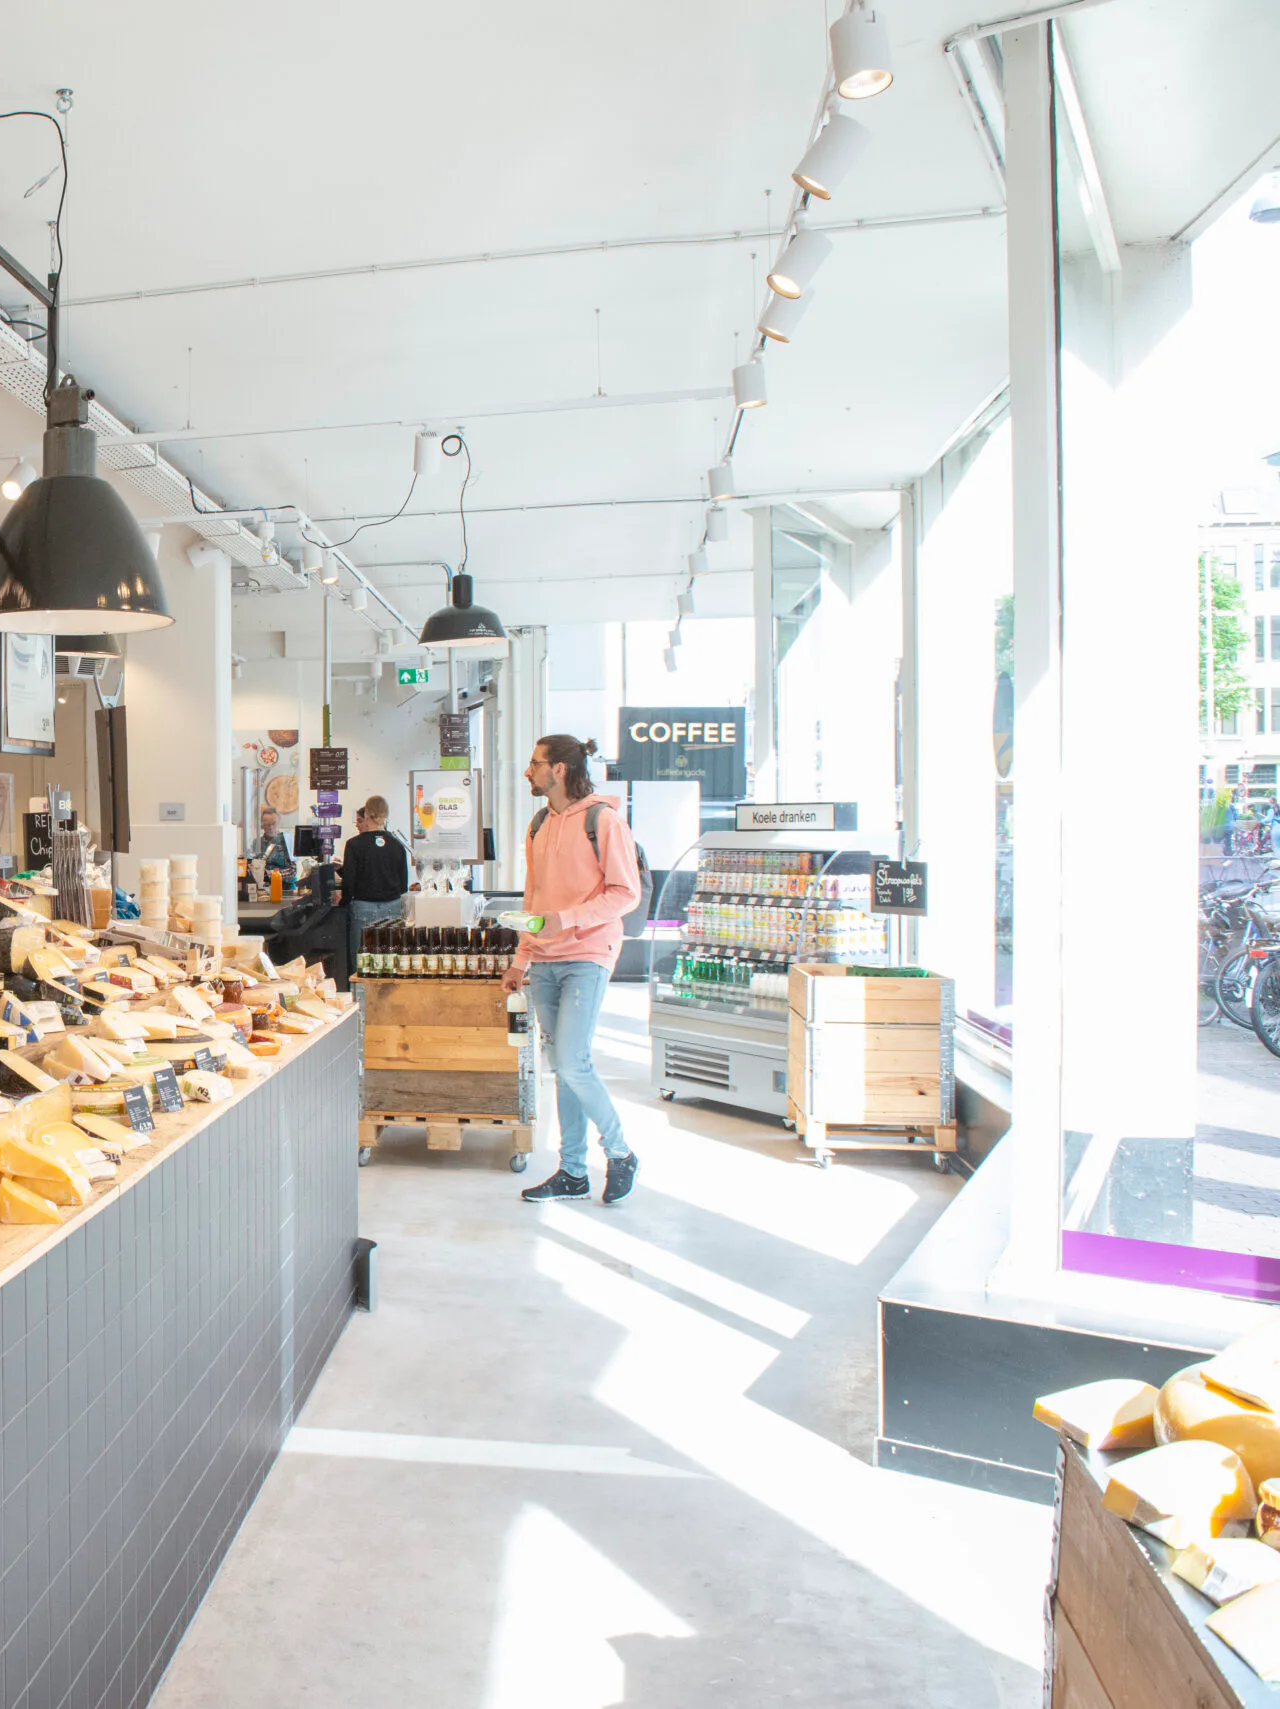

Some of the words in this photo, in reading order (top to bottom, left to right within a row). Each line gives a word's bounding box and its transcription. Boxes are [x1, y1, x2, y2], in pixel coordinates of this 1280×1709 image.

[629, 721, 737, 743] COFFEE
[752, 811, 777, 824] Koele
[779, 810, 816, 823] dranken
